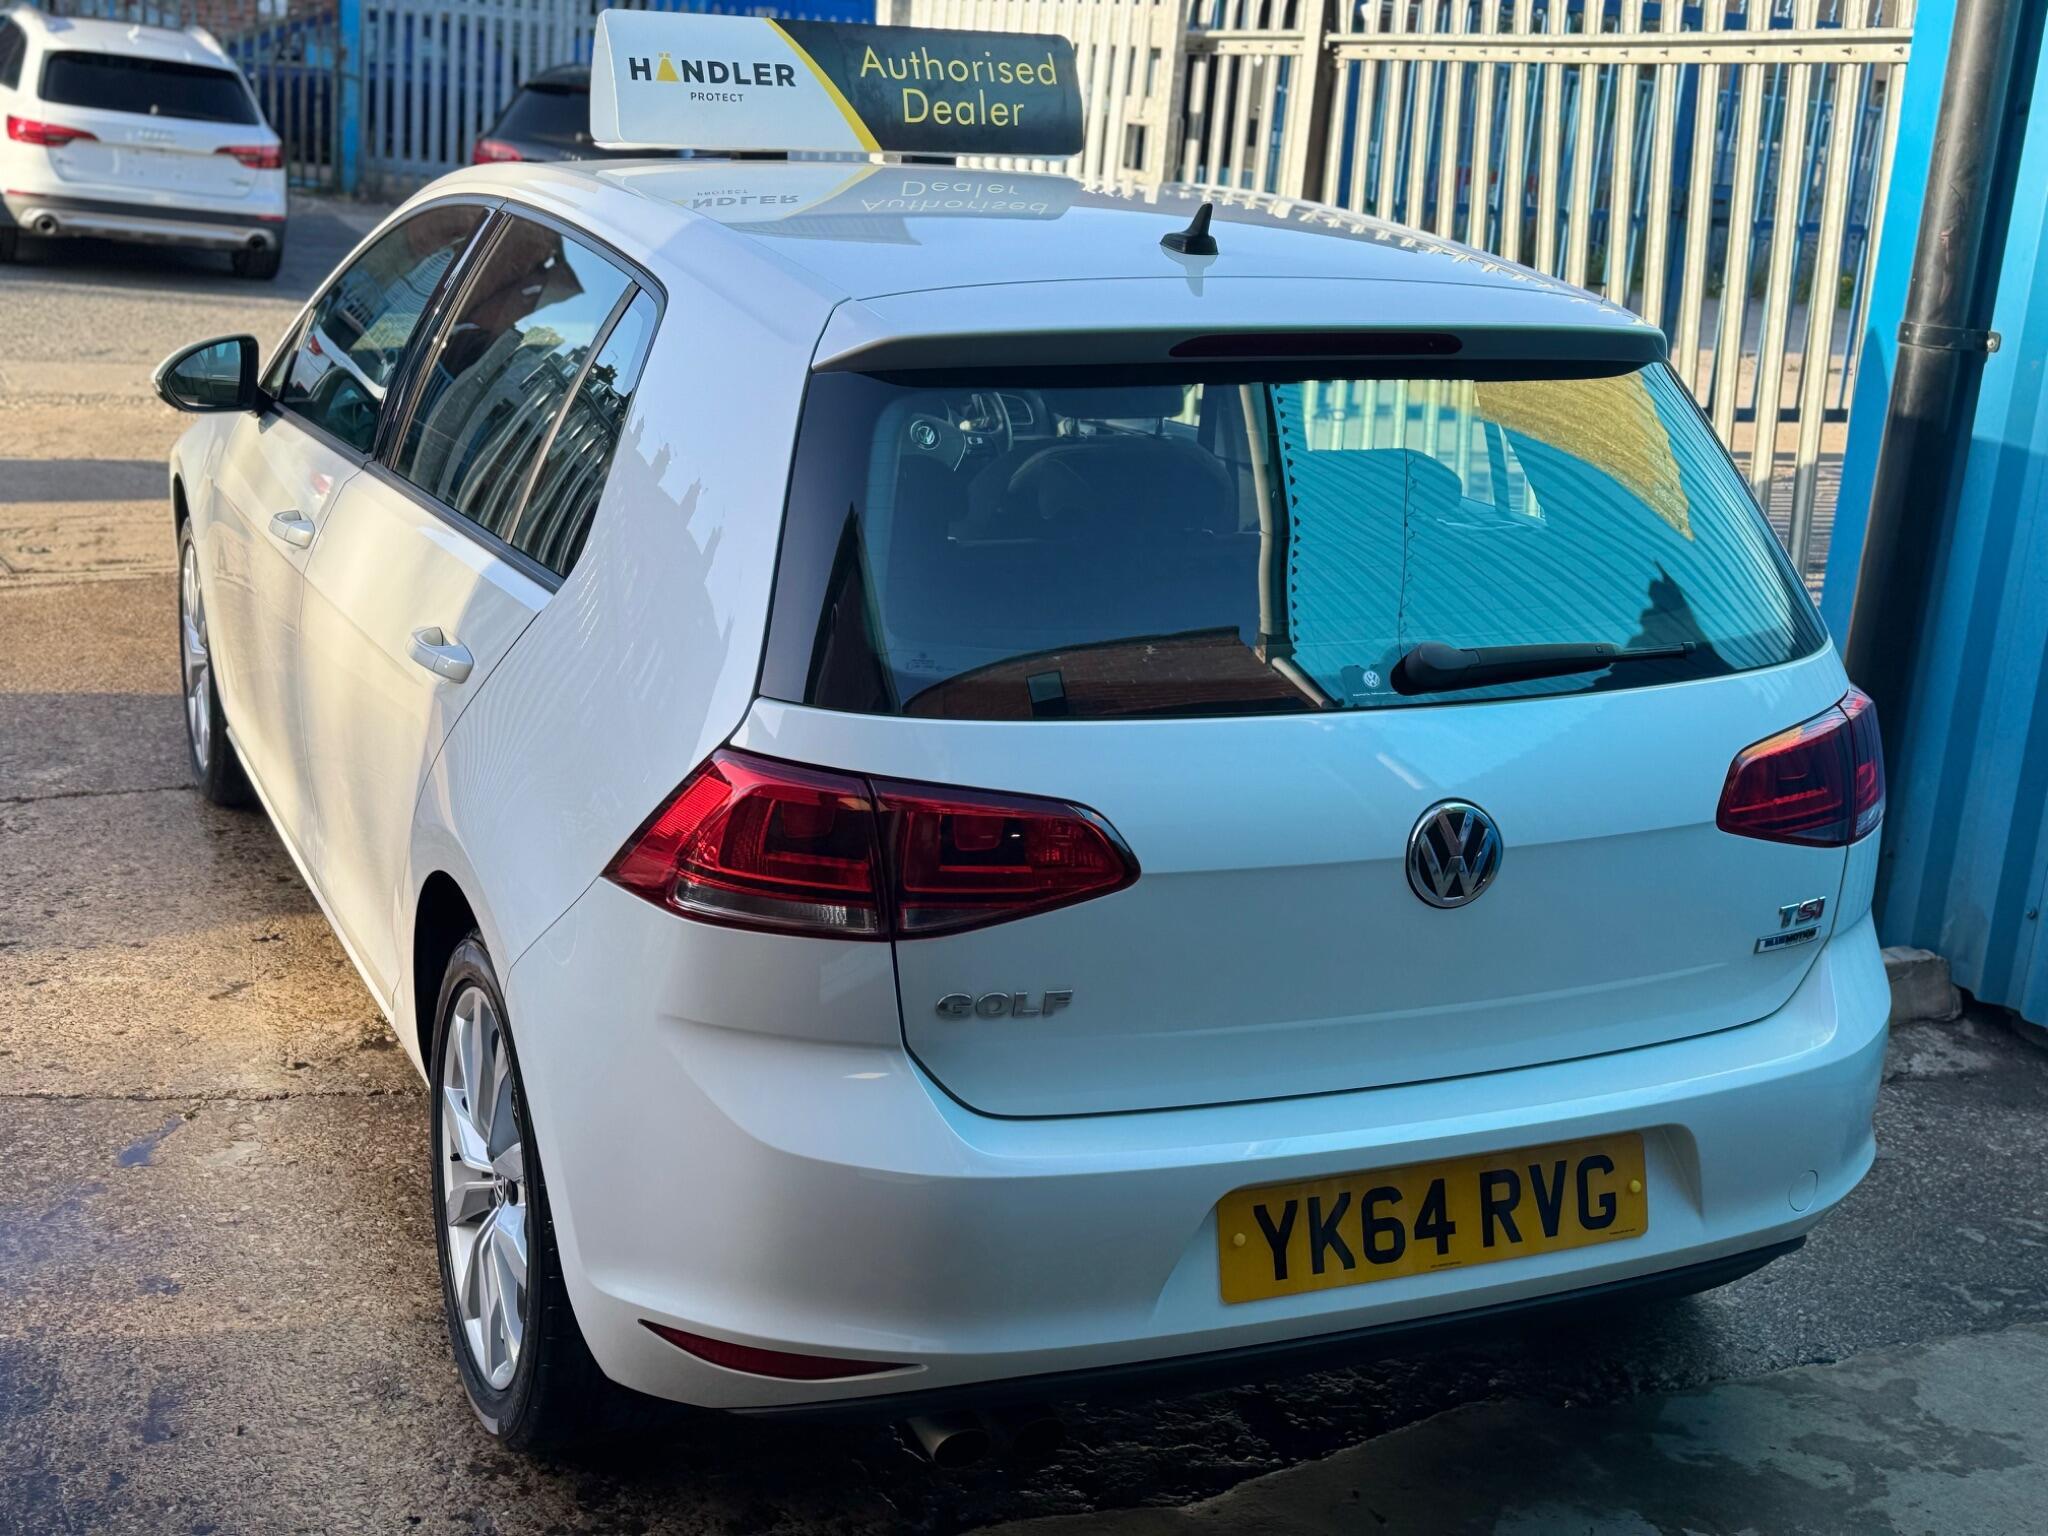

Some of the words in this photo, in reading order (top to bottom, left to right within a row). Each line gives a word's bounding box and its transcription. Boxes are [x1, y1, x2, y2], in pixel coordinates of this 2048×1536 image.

[860, 45, 1058, 85] Authorised
[690, 91, 744, 103] PROTECT
[902, 88, 1025, 127] Dealer
[1779, 896, 1826, 928] TSI
[936, 990, 1073, 1018] GOLF
[1253, 1178, 1456, 1281] YK64
[1479, 1154, 1616, 1248] RVG
